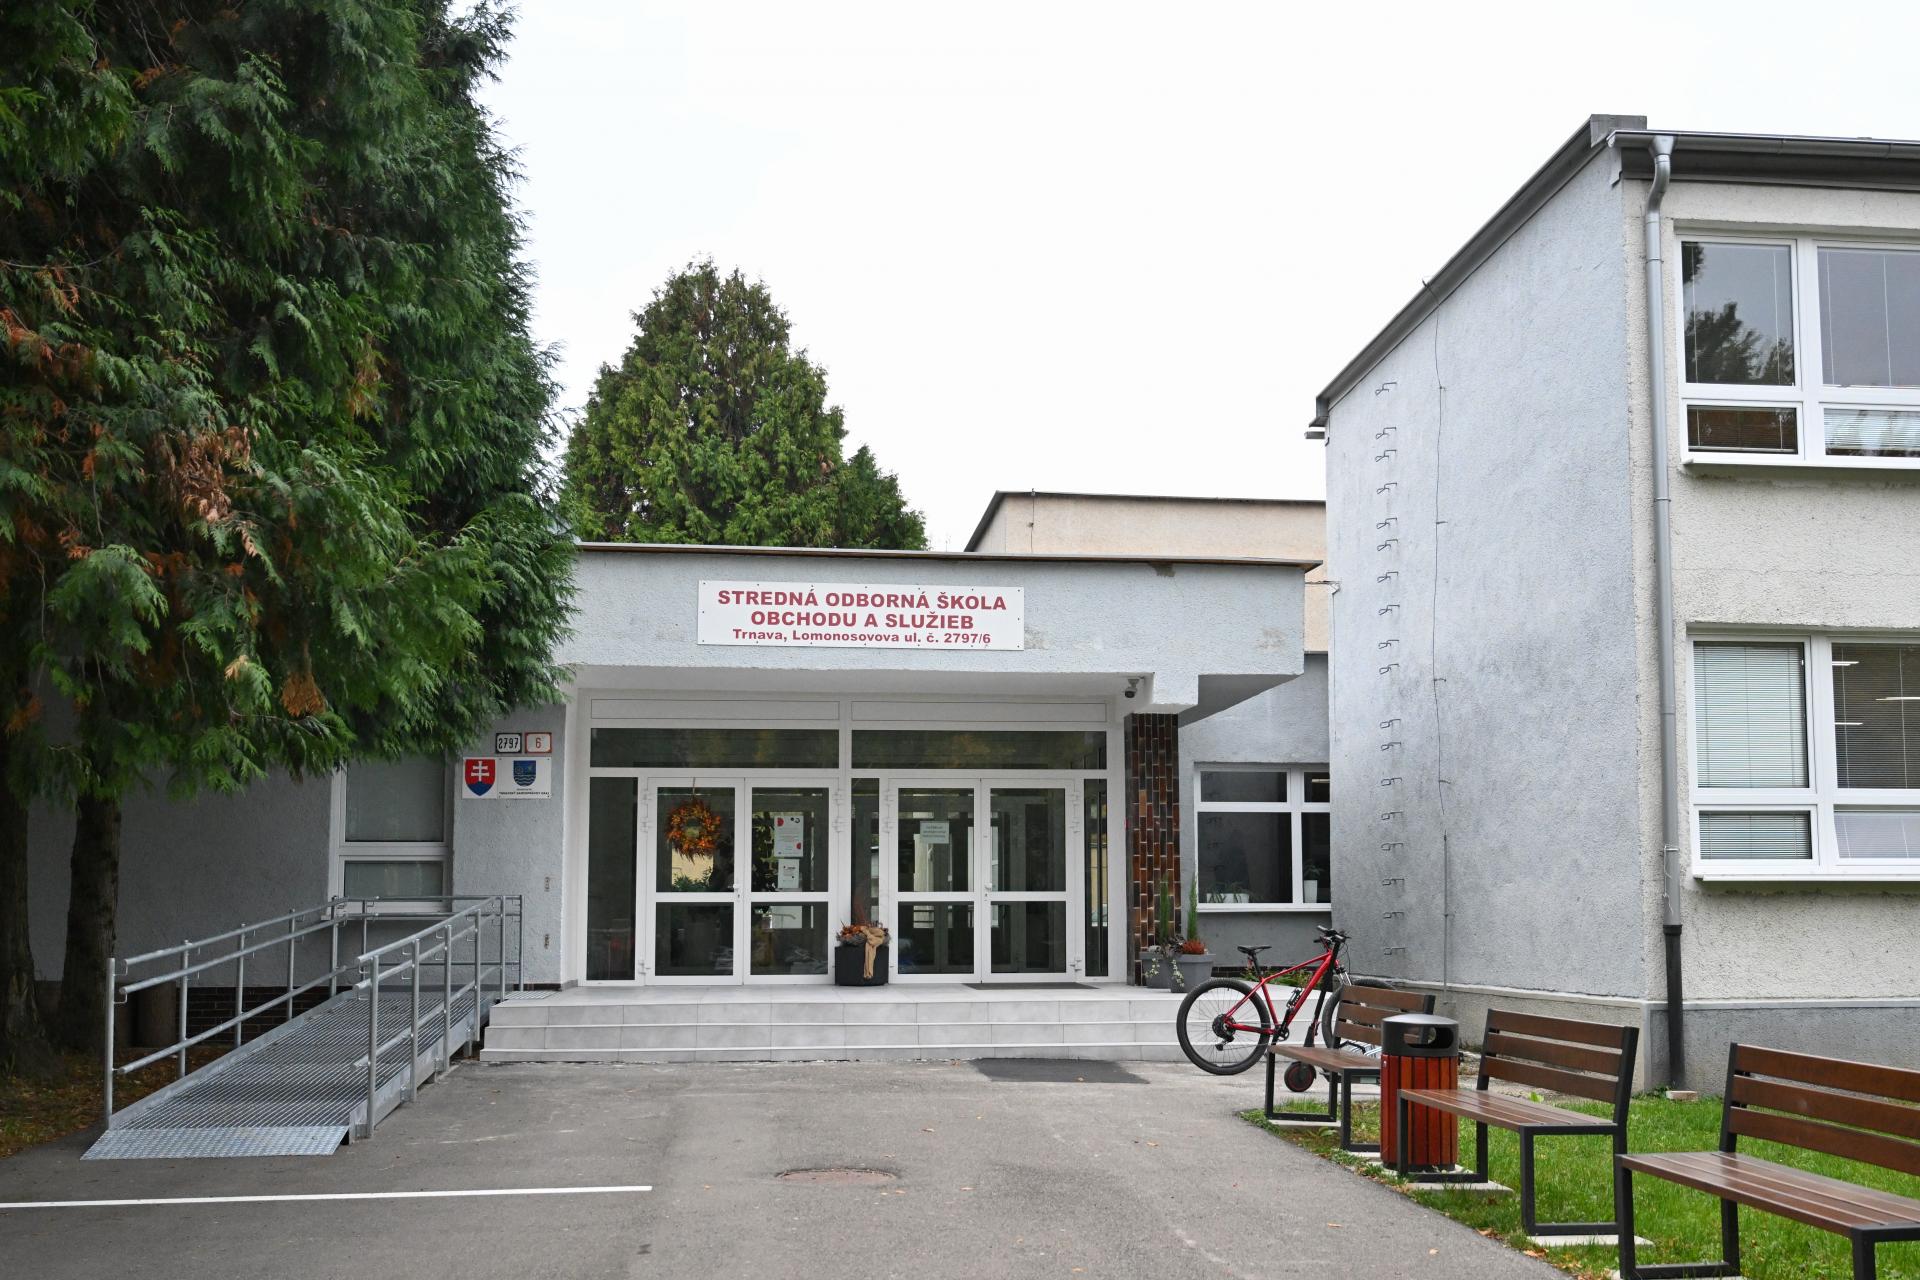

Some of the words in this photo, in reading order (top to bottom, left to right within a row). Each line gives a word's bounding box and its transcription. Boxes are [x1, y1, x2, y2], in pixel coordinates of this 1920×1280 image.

[718, 588, 818, 606] STREDNÁ
[825, 591, 930, 609] ODBORNÁ
[937, 592, 1007, 610] ŠKOLA
[750, 611, 857, 627] OBCHODU
[864, 613, 879, 627] A
[885, 611, 974, 630] SLUŽIEB
[733, 628, 788, 642] Trnava,
[792, 630, 900, 642] Lomonosovova
[904, 632, 921, 643] ul.
[927, 632, 939, 643] č.
[944, 632, 991, 644] 2797/6
[498, 737, 519, 749] 2797
[535, 737, 542, 749] 6
